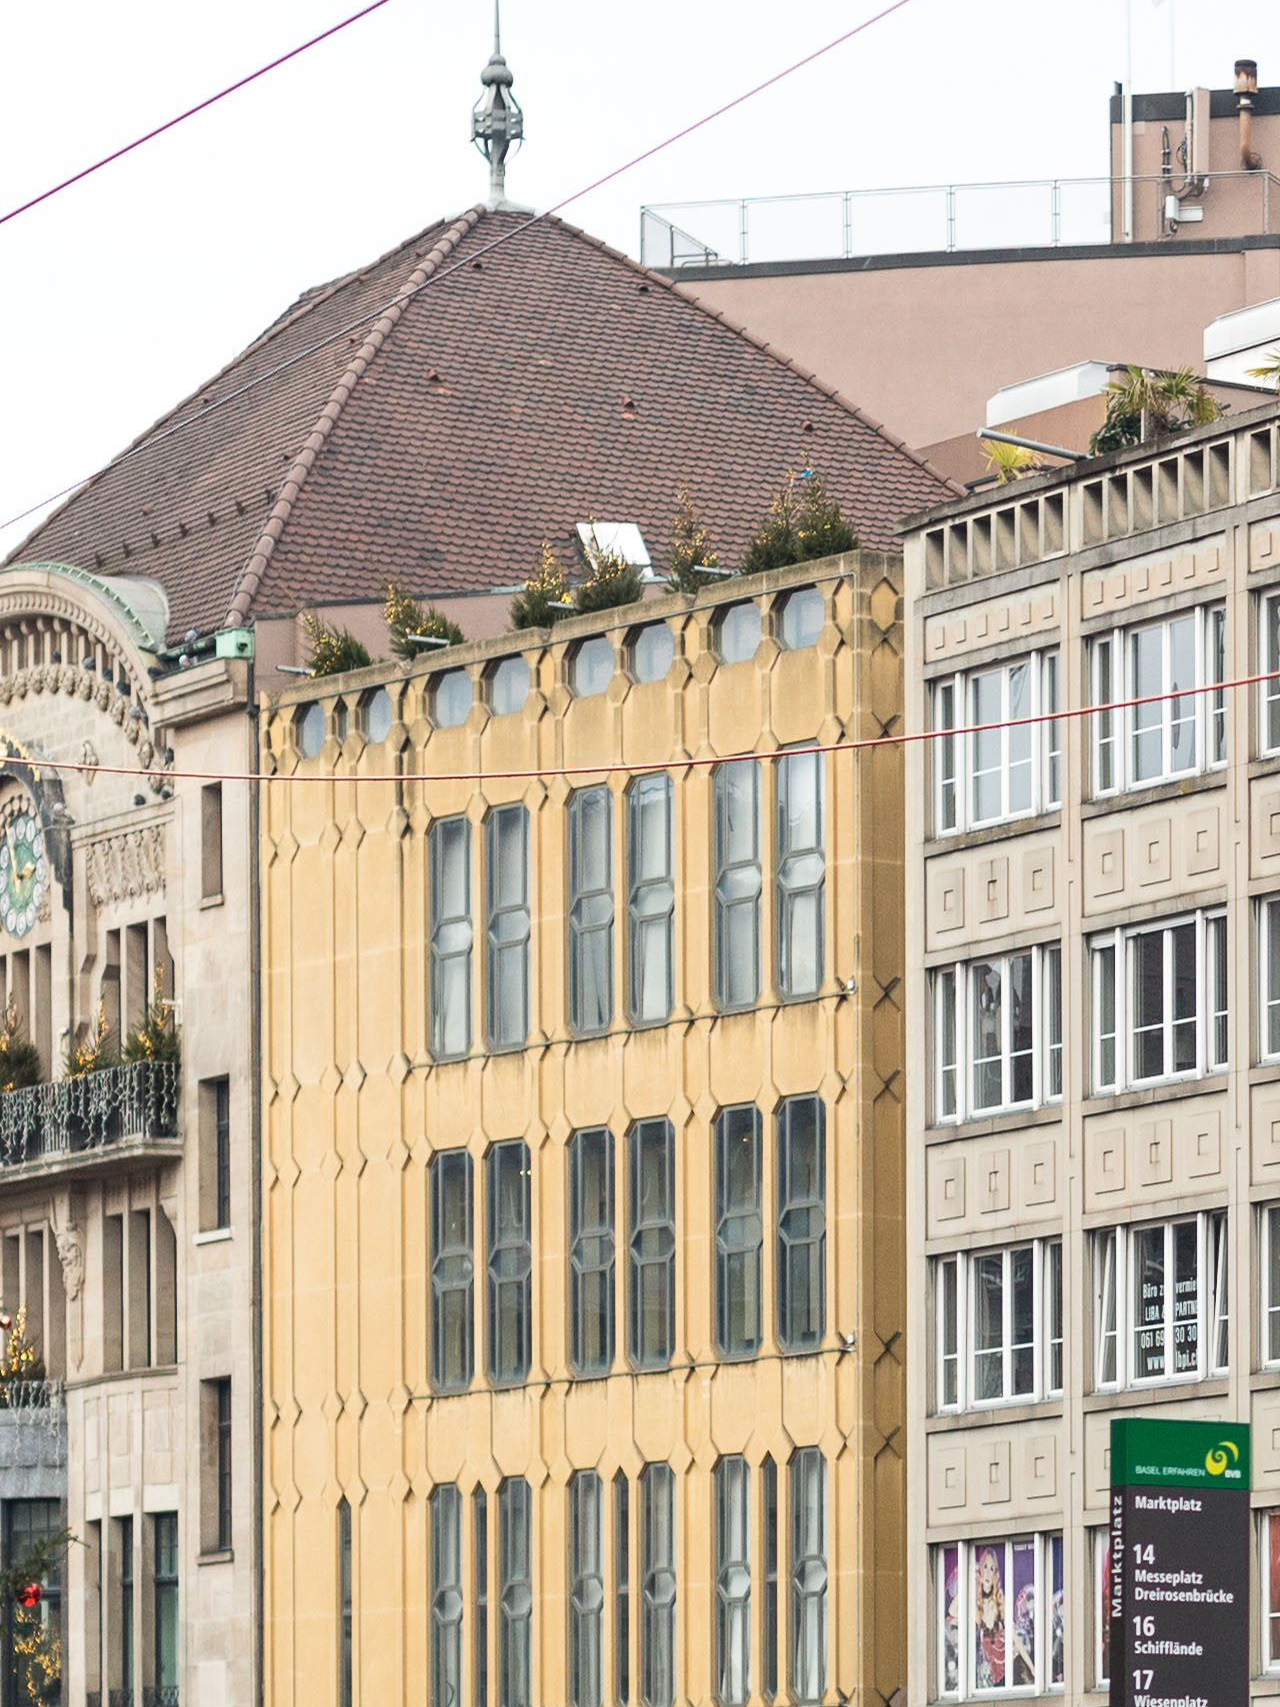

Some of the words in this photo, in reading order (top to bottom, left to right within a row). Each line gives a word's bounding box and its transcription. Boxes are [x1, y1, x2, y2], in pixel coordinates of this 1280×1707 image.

[1135, 1465, 1161, 1475] BASEL
[1162, 1466, 1206, 1477] ERFAHREN
[1224, 1469, 1242, 1479] BVB
[1135, 1496, 1202, 1513] Marktplatz
[1111, 1496, 1124, 1617] Marktplatz
[1133, 1544, 1156, 1565] 14
[1134, 1569, 1203, 1587] Messeplatz
[1134, 1587, 1234, 1603] Dreirosenbrücke
[1133, 1615, 1156, 1636] 16
[1134, 1640, 1203, 1656] Schifflände
[1133, 1670, 1154, 1690] 17
